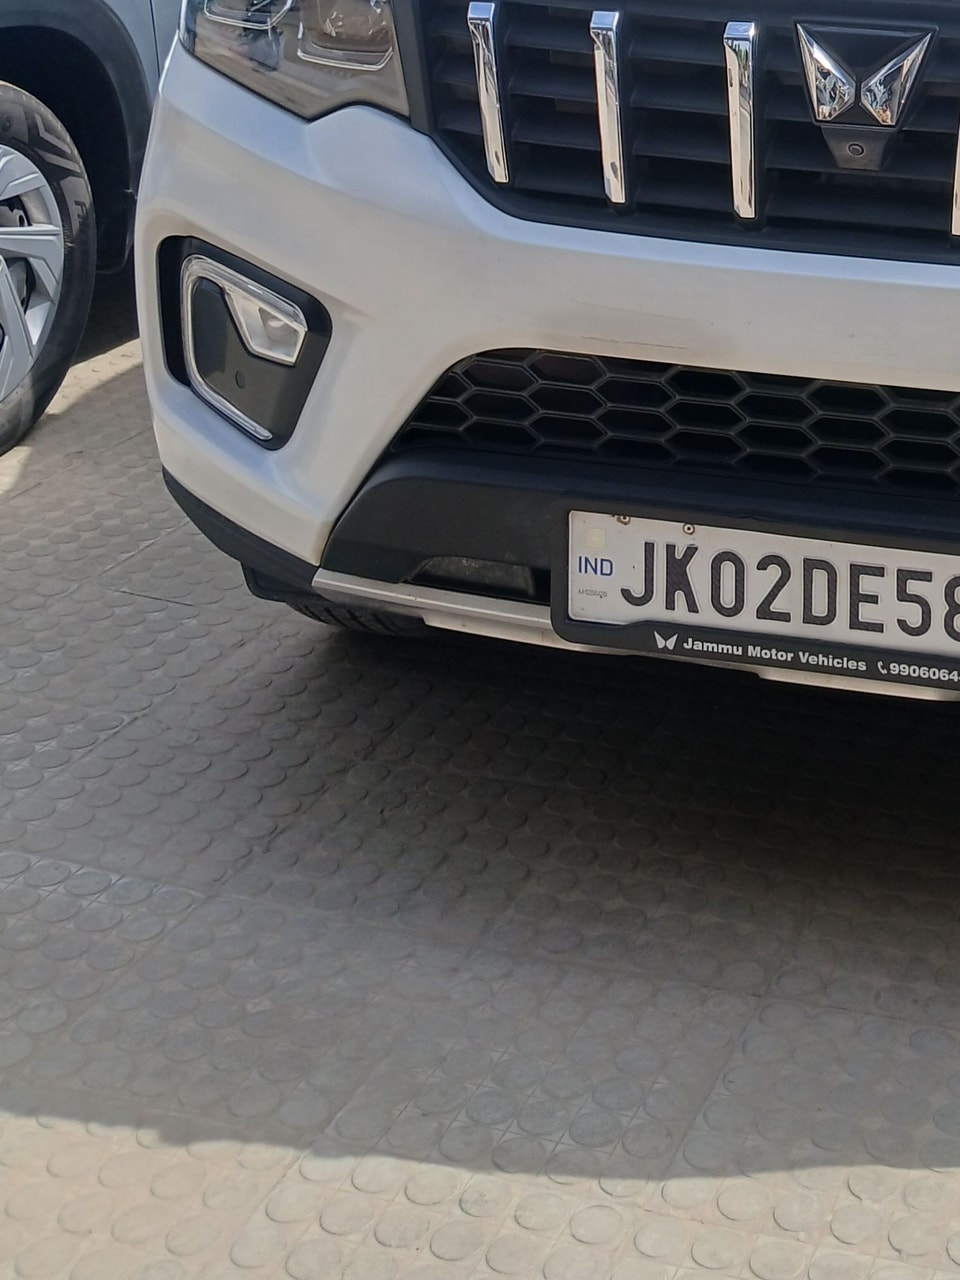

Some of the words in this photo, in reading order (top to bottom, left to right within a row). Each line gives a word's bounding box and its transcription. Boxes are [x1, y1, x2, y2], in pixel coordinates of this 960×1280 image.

[578, 555, 614, 577] IND
[683, 637, 743, 656] Jammu
[747, 645, 794, 663] Motor
[798, 651, 867, 671] Vehicles
